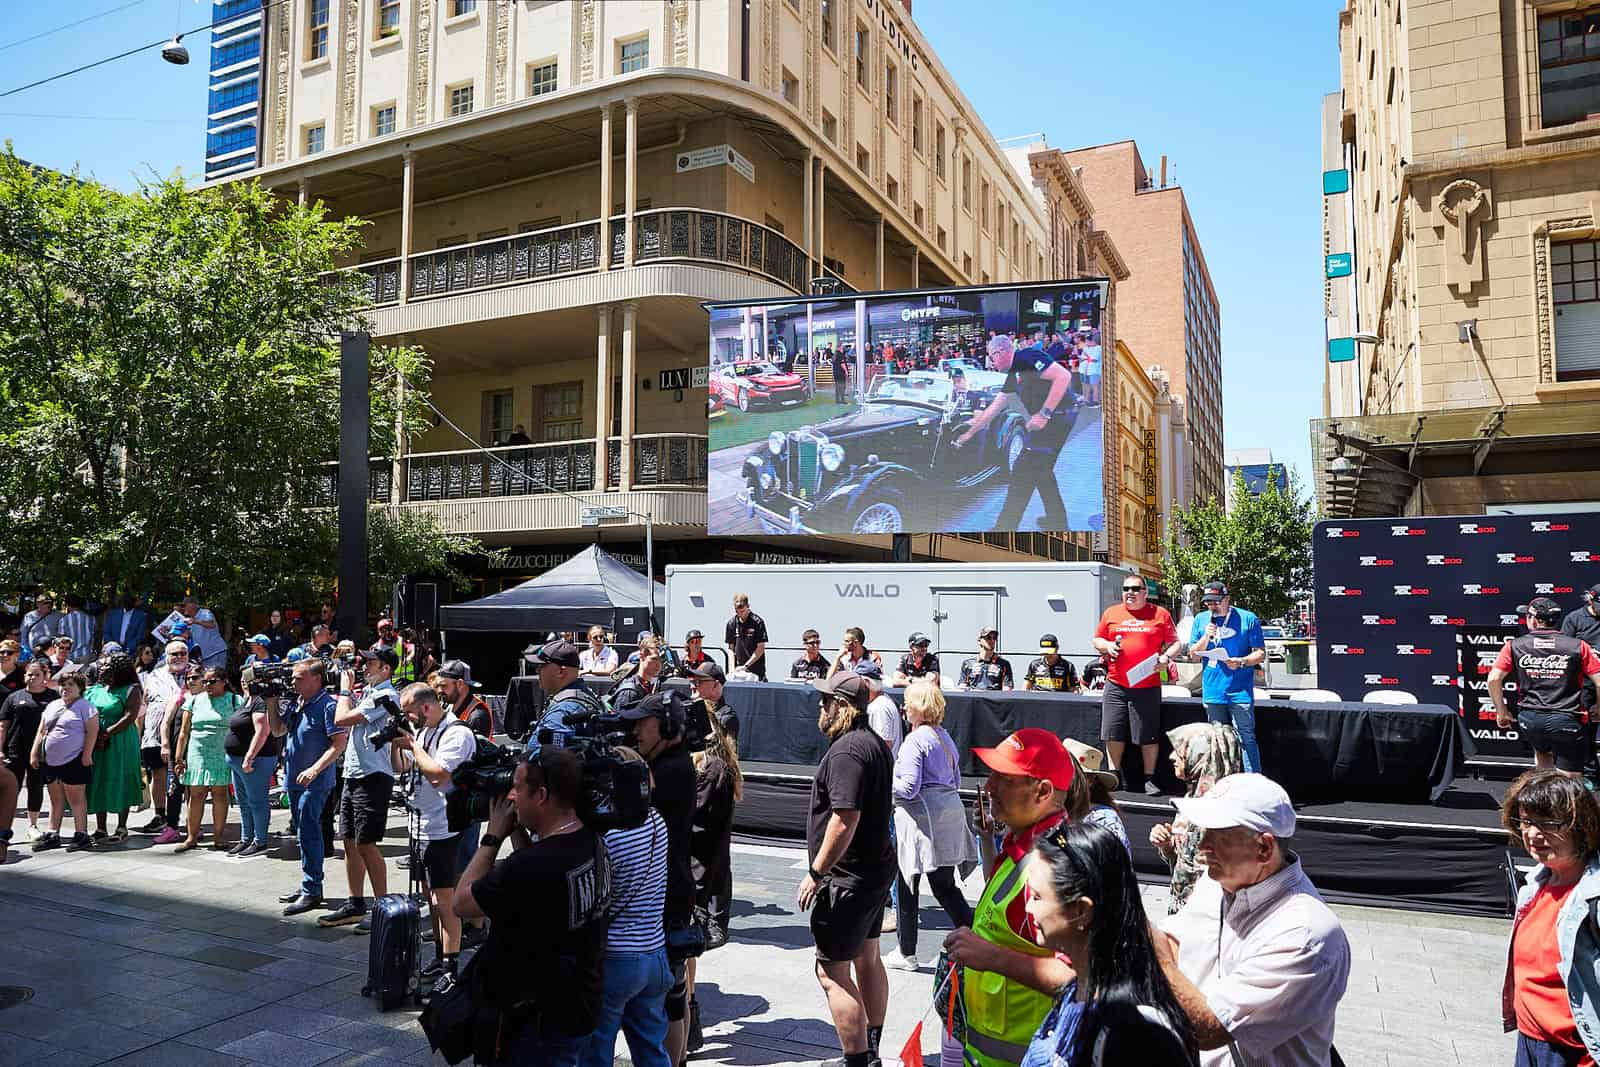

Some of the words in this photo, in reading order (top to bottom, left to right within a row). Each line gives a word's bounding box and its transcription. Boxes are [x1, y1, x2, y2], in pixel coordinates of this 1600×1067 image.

[1074, 289, 1100, 300] HYP
[834, 583, 901, 598] VAILO
[1519, 654, 1570, 669] Coca-Cola
[1468, 681, 1518, 691] VAO
[1469, 729, 1518, 740] VAILO
